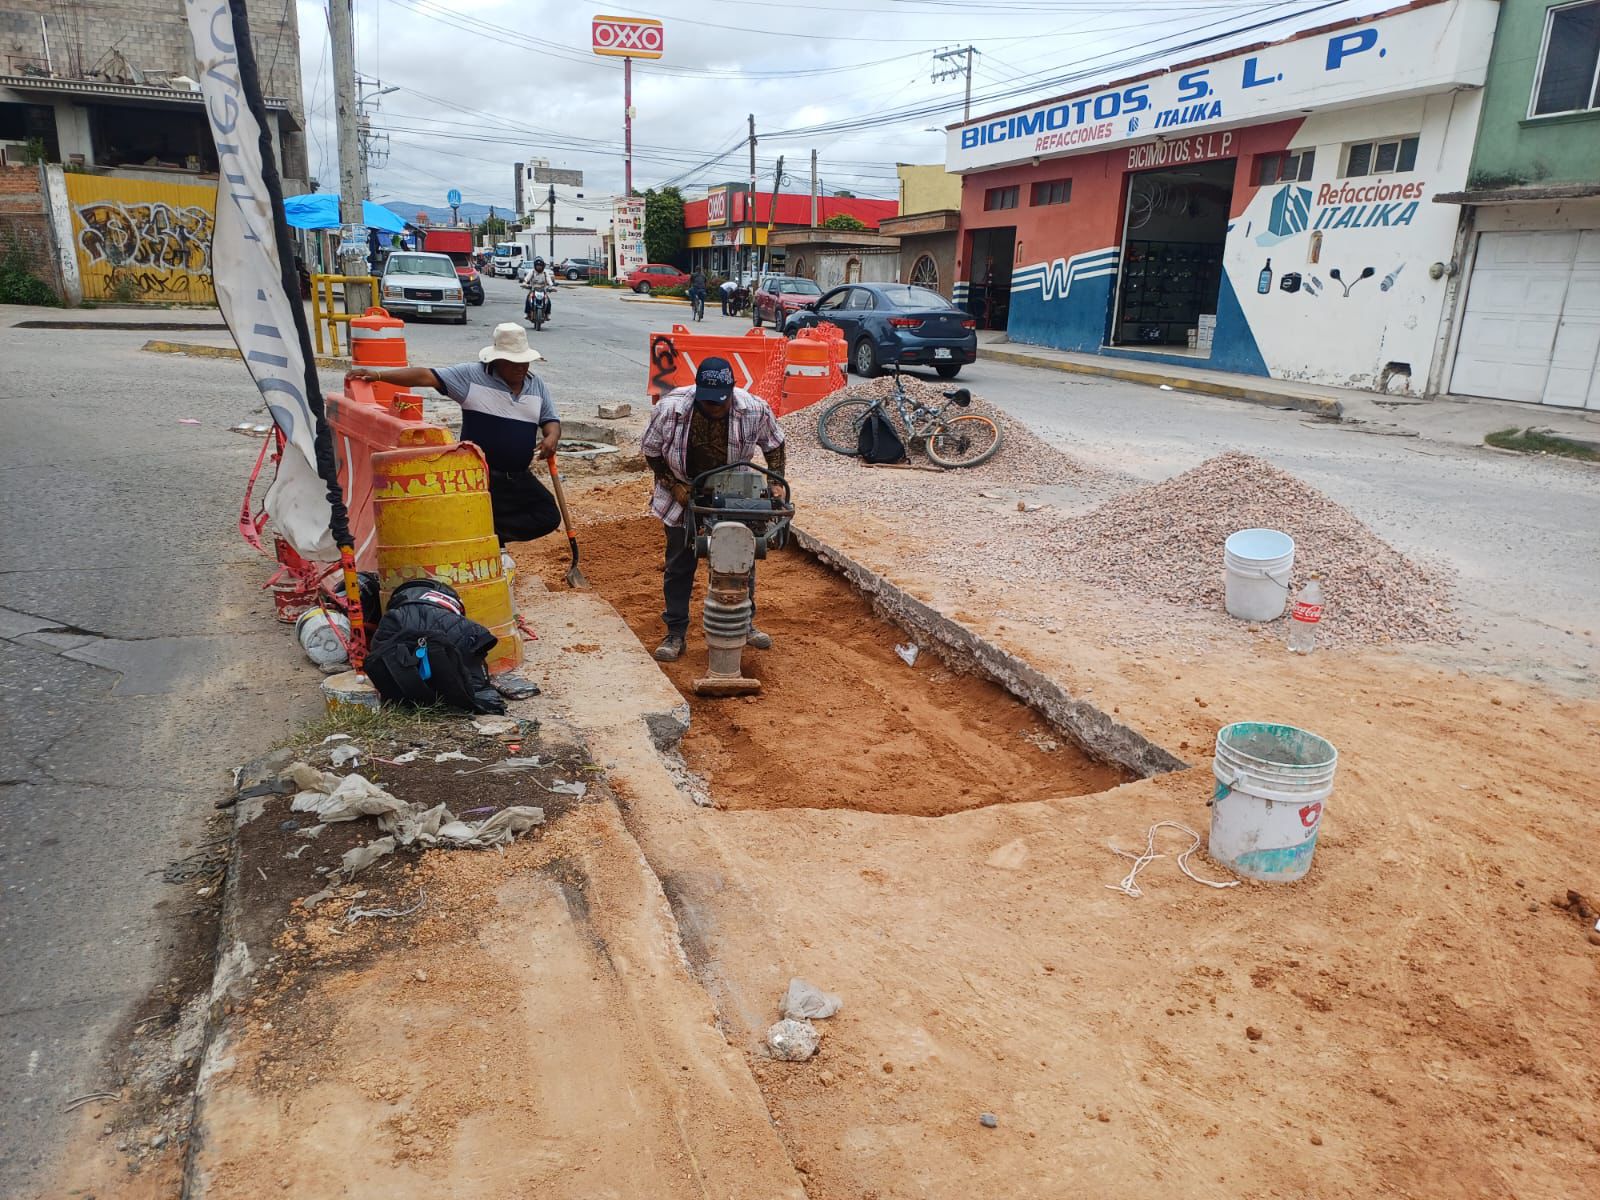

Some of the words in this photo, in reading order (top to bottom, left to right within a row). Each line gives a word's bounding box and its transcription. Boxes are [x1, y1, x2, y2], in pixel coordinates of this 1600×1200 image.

[595, 24, 661, 50] OXXO
[1177, 69, 1214, 102] S.
[1241, 57, 1283, 89] L.
[1325, 28, 1386, 71] P.
[1035, 122, 1113, 152] REFACCIONES
[1154, 100, 1222, 129] ITALIKA
[1194, 137, 1204, 159] S.
[1207, 135, 1218, 158] L.
[1220, 132, 1232, 156] P.
[1316, 178, 1425, 206] Refacciones
[708, 193, 725, 220] OXXO
[1313, 201, 1420, 230] ITALIKA
